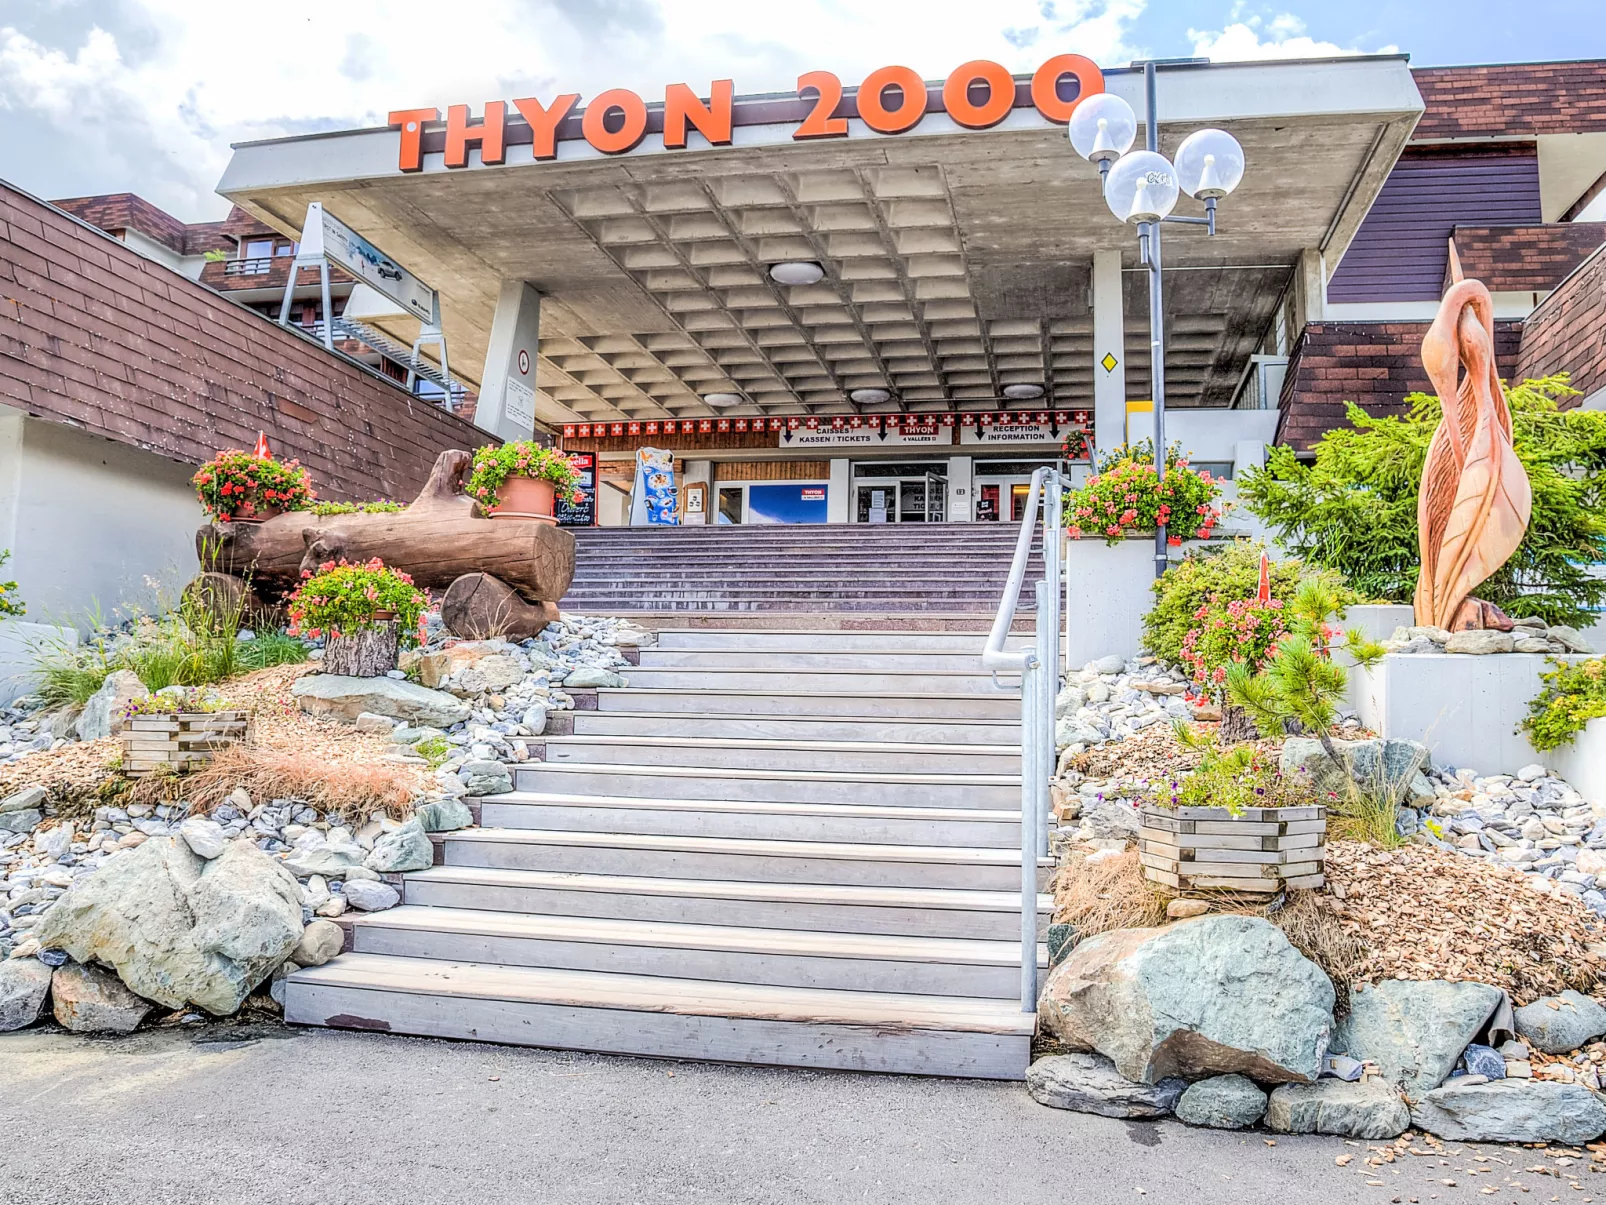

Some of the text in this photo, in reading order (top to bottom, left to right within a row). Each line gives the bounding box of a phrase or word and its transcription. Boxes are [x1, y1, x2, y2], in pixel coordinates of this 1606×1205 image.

[388, 53, 1106, 173] THYON 2000
[816, 427, 850, 435] CAISSES
[904, 426, 934, 434] THYON
[988, 433, 1045, 441] INFORMATION
